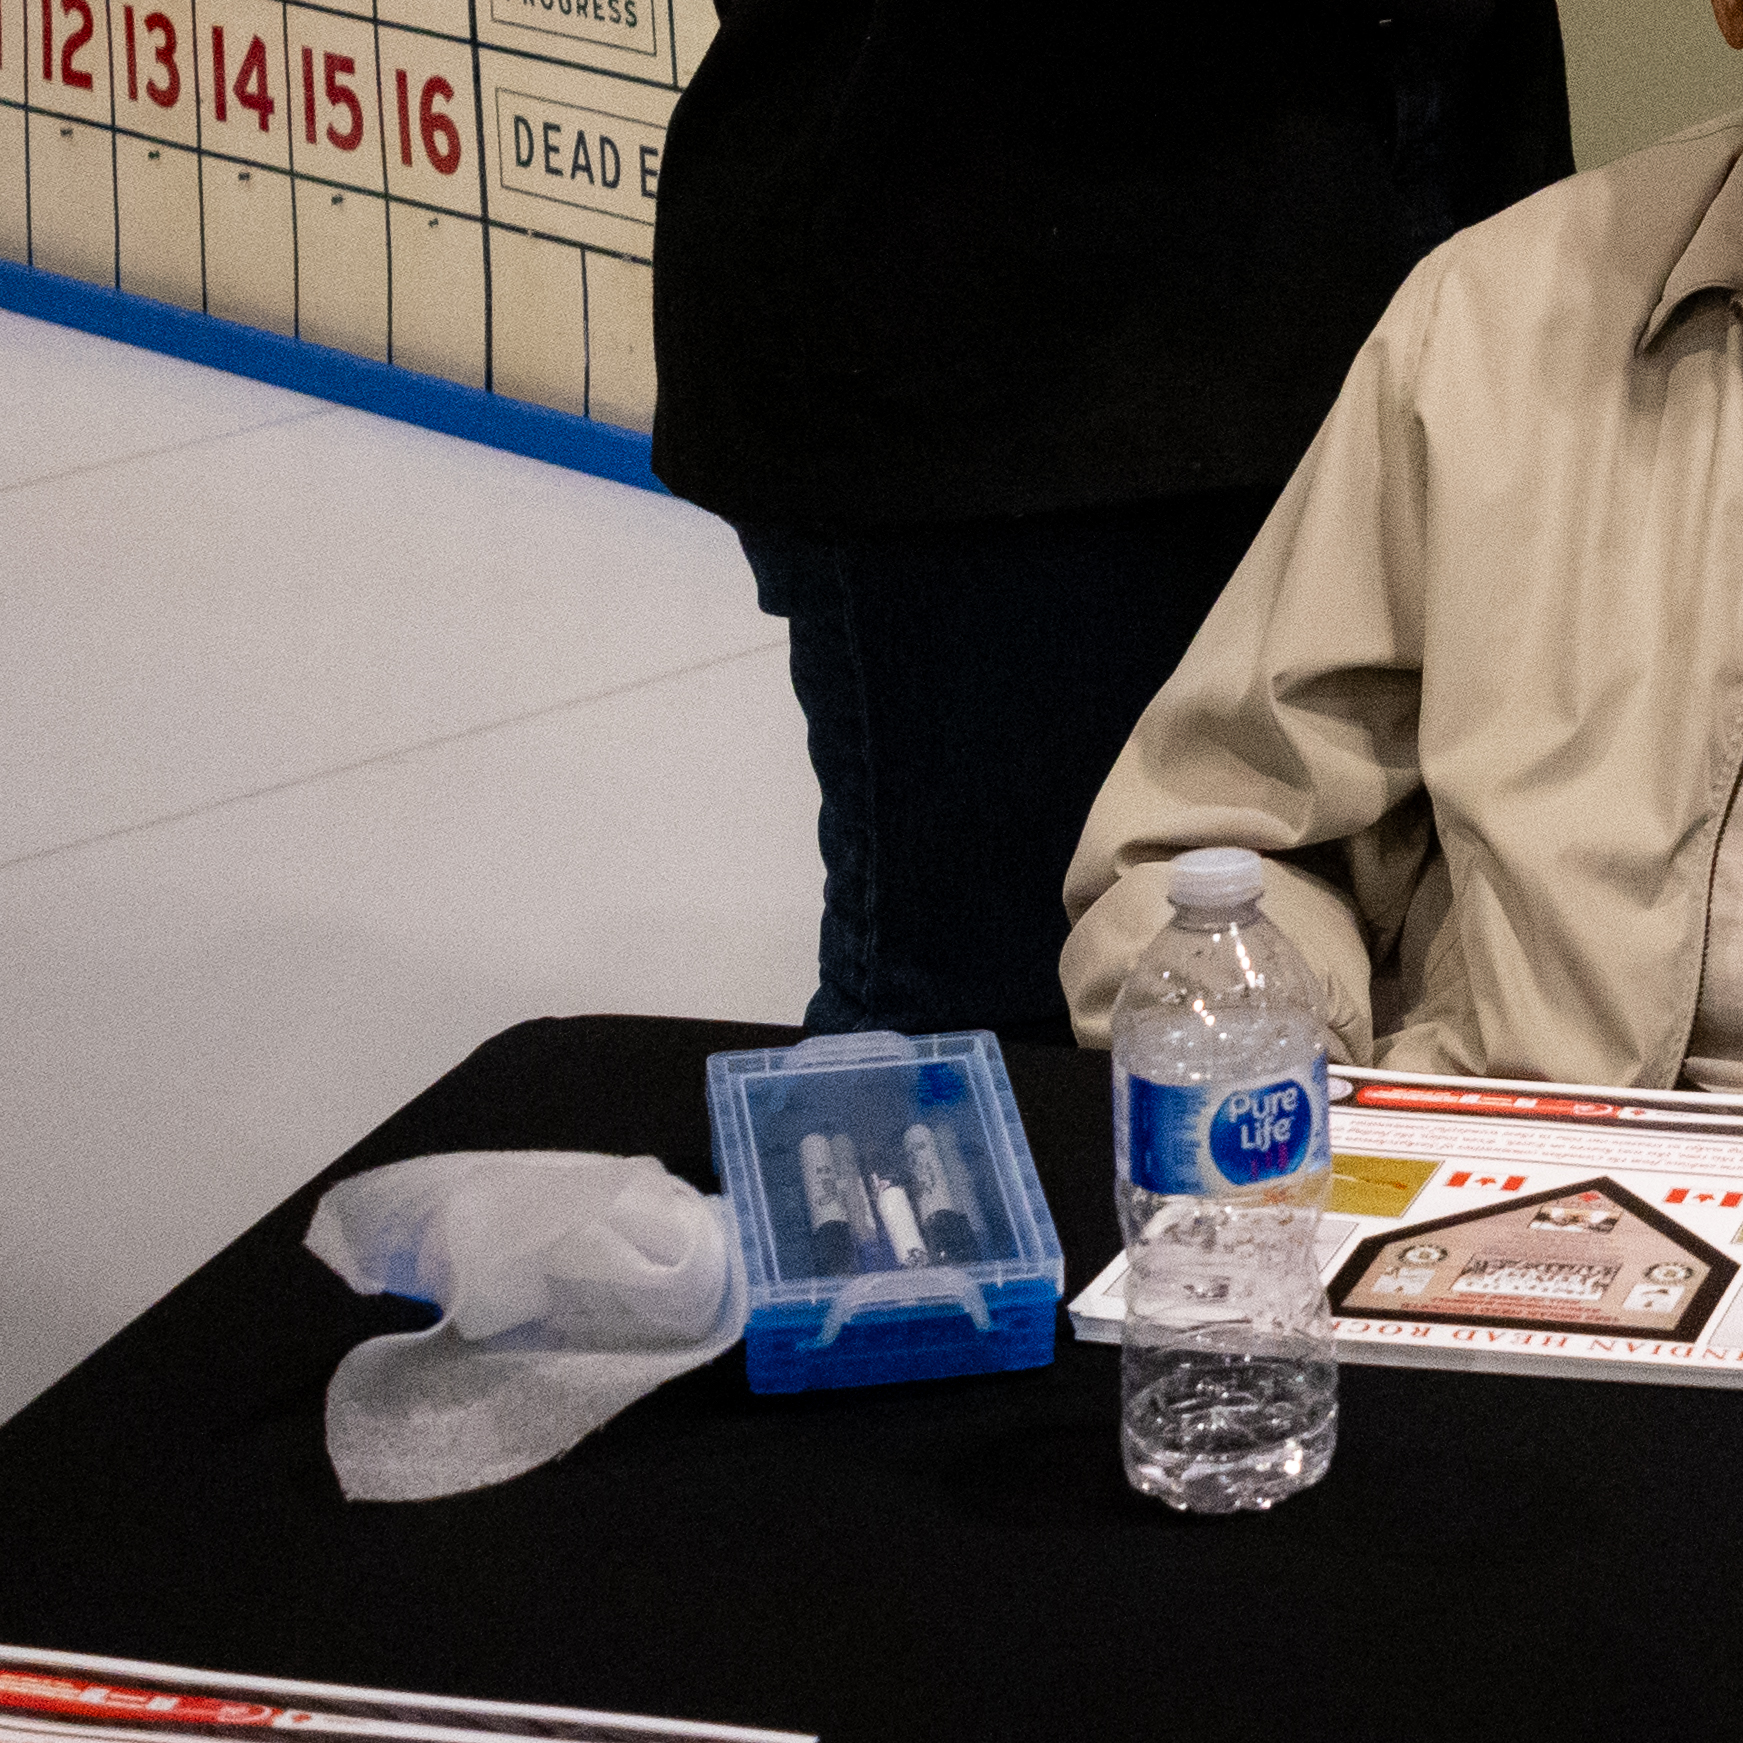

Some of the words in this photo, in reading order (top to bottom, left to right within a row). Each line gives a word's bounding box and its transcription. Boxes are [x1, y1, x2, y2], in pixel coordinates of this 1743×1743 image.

[123, 5, 182, 109] 13
[211, 24, 276, 133] 14
[302, 47, 365, 153] 15
[396, 69, 462, 176] 16
[513, 114, 622, 191] DEAD
[1229, 1087, 1298, 1123] Pure
[1241, 1116, 1296, 1152] Life
[1450, 1328, 1569, 1348] HEAD
